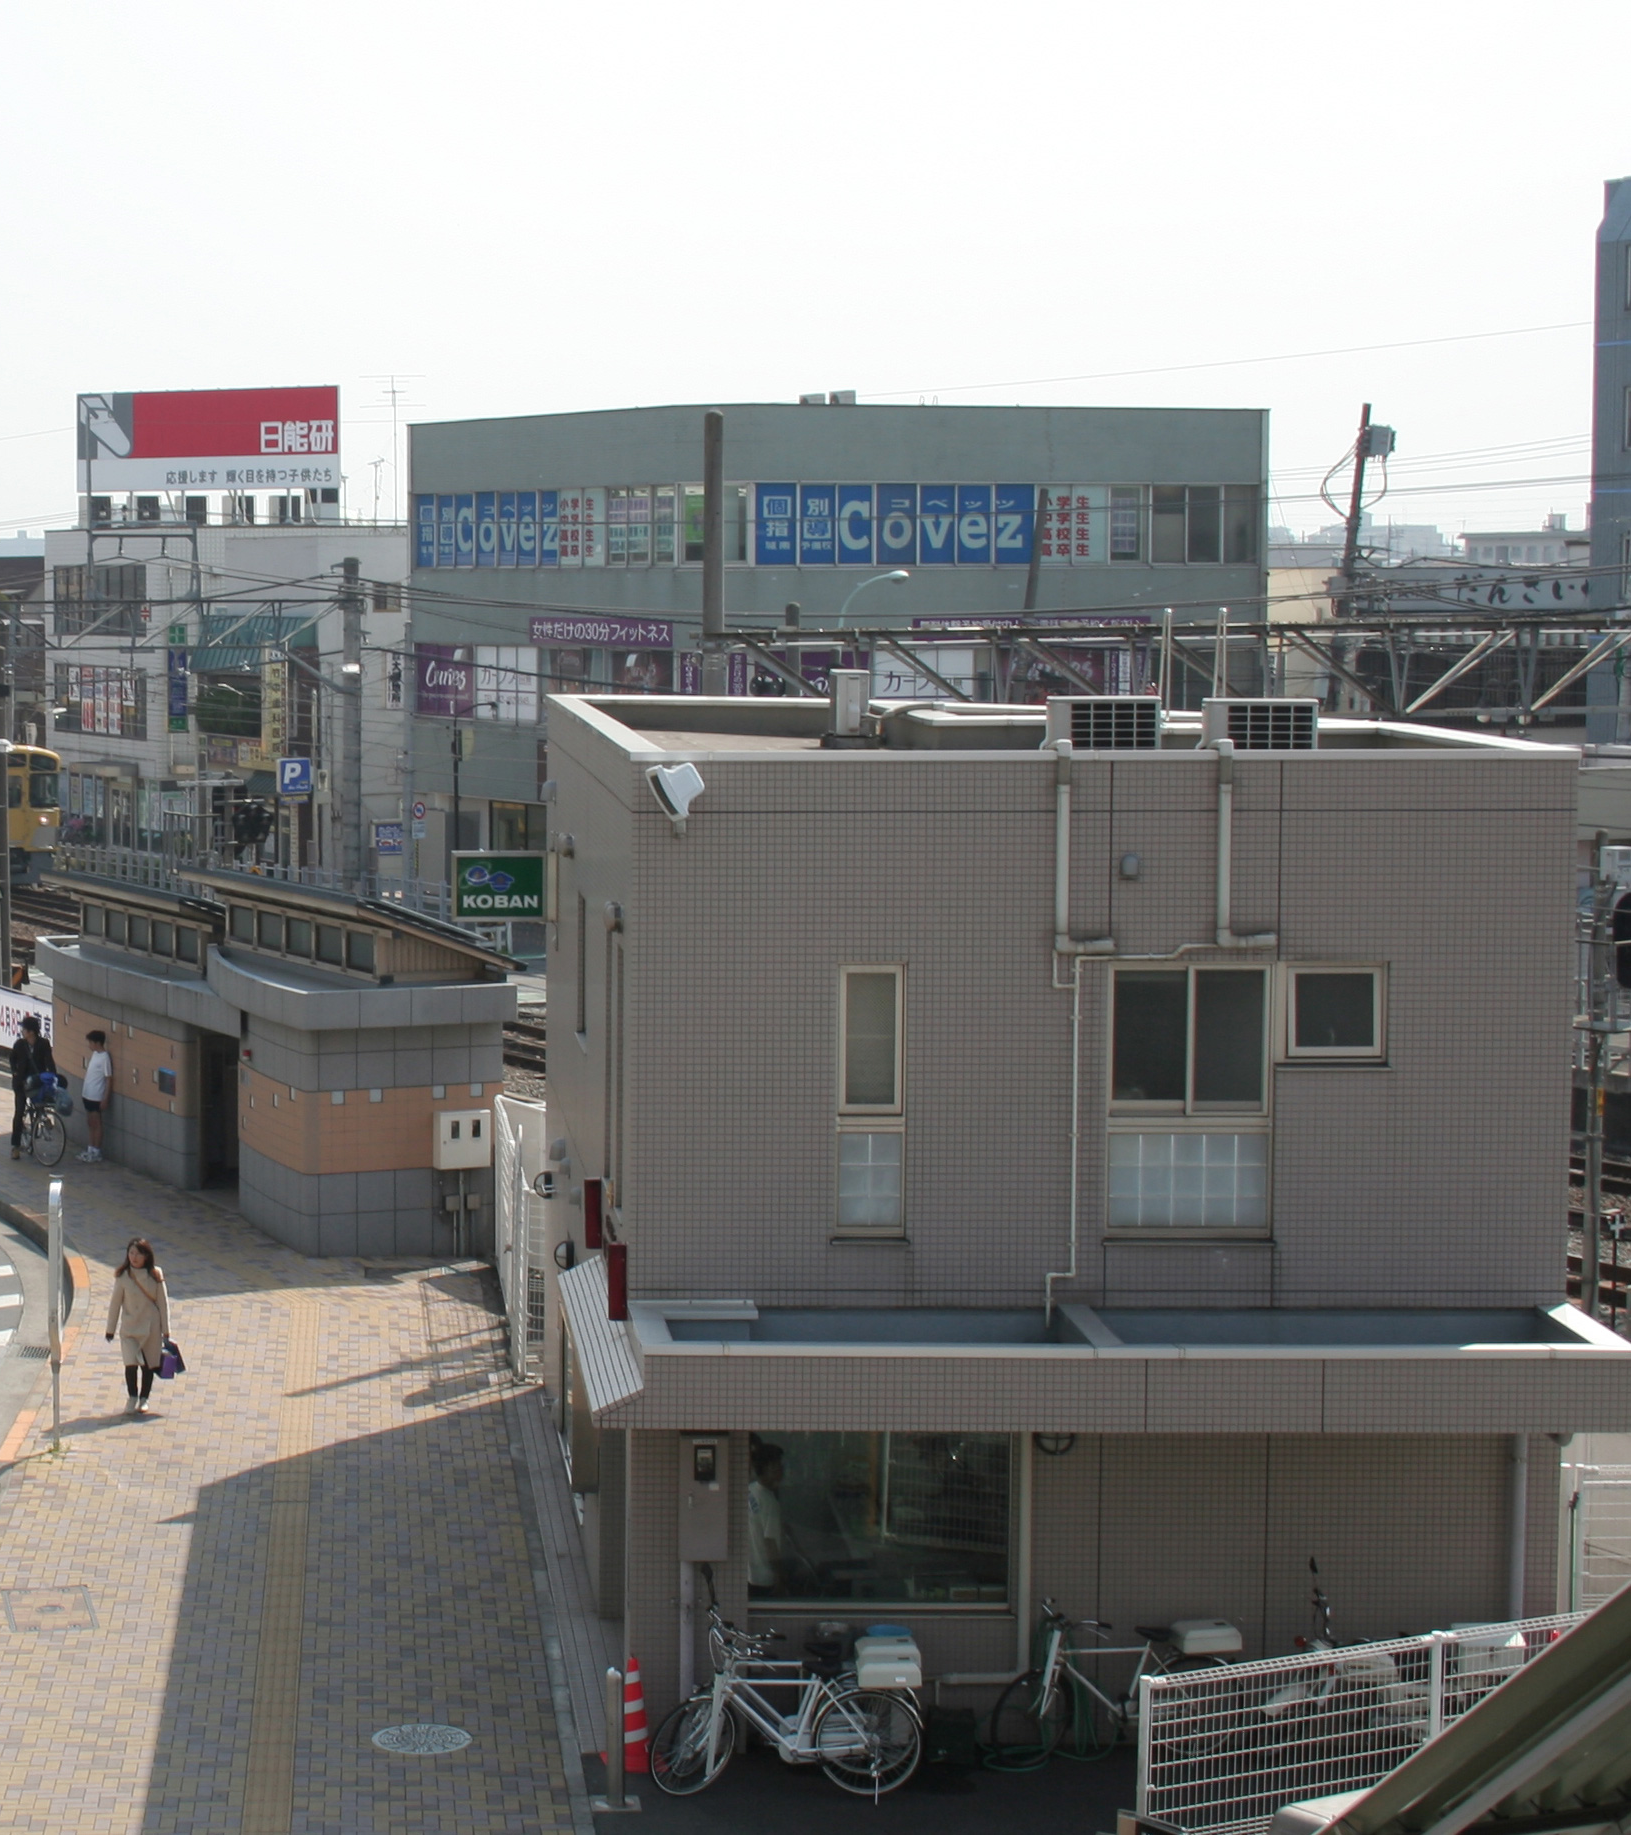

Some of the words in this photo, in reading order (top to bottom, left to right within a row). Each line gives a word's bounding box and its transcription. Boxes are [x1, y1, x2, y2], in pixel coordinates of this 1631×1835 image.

[260, 420, 334, 453] 日能研
[166, 470, 218, 485] 応援します
[226, 468, 332, 484] 輝く目を持つ子供たち
[484, 504, 553, 514] コベッツ
[560, 498, 594, 511] 小学生
[890, 499, 1014, 509] コベッツ
[457, 507, 557, 552] Covez
[839, 500, 1023, 550] Covez
[560, 529, 594, 542] 高校生
[560, 544, 594, 557] 高卒生
[532, 621, 670, 643] 女性だけの30分フィットネス
[283, 762, 302, 784] P
[463, 895, 538, 909] KOBAN
